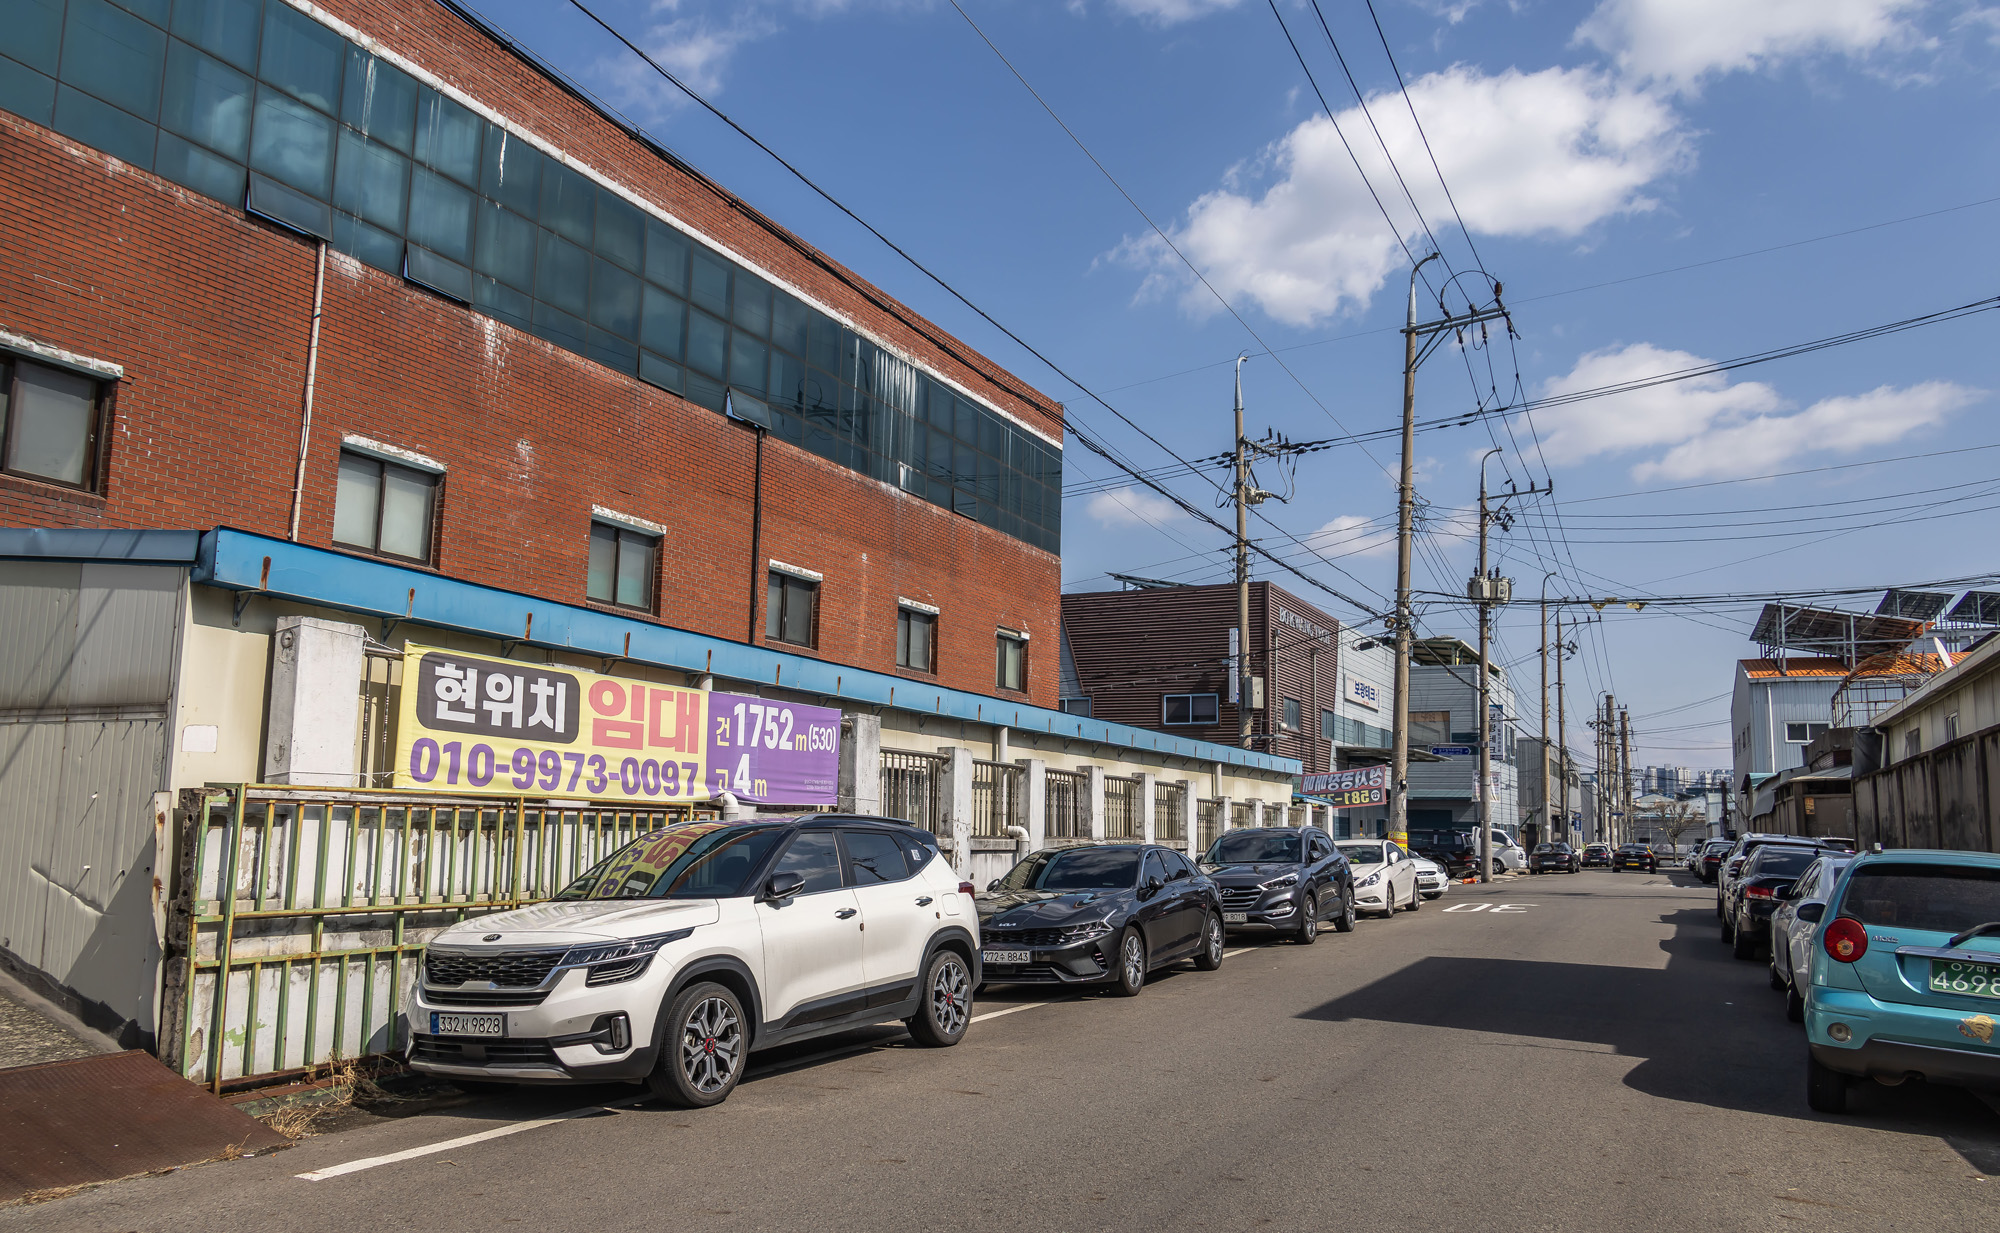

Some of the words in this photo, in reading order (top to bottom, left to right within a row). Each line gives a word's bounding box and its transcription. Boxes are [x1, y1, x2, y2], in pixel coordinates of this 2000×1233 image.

[1354, 680, 1376, 701] 보광테크
[434, 662, 566, 733] 현위치
[588, 679, 698, 754] 임대
[715, 716, 730, 747] 건
[409, 737, 699, 797] 010-9973-0097
[1950, 962, 1988, 975] 07마
